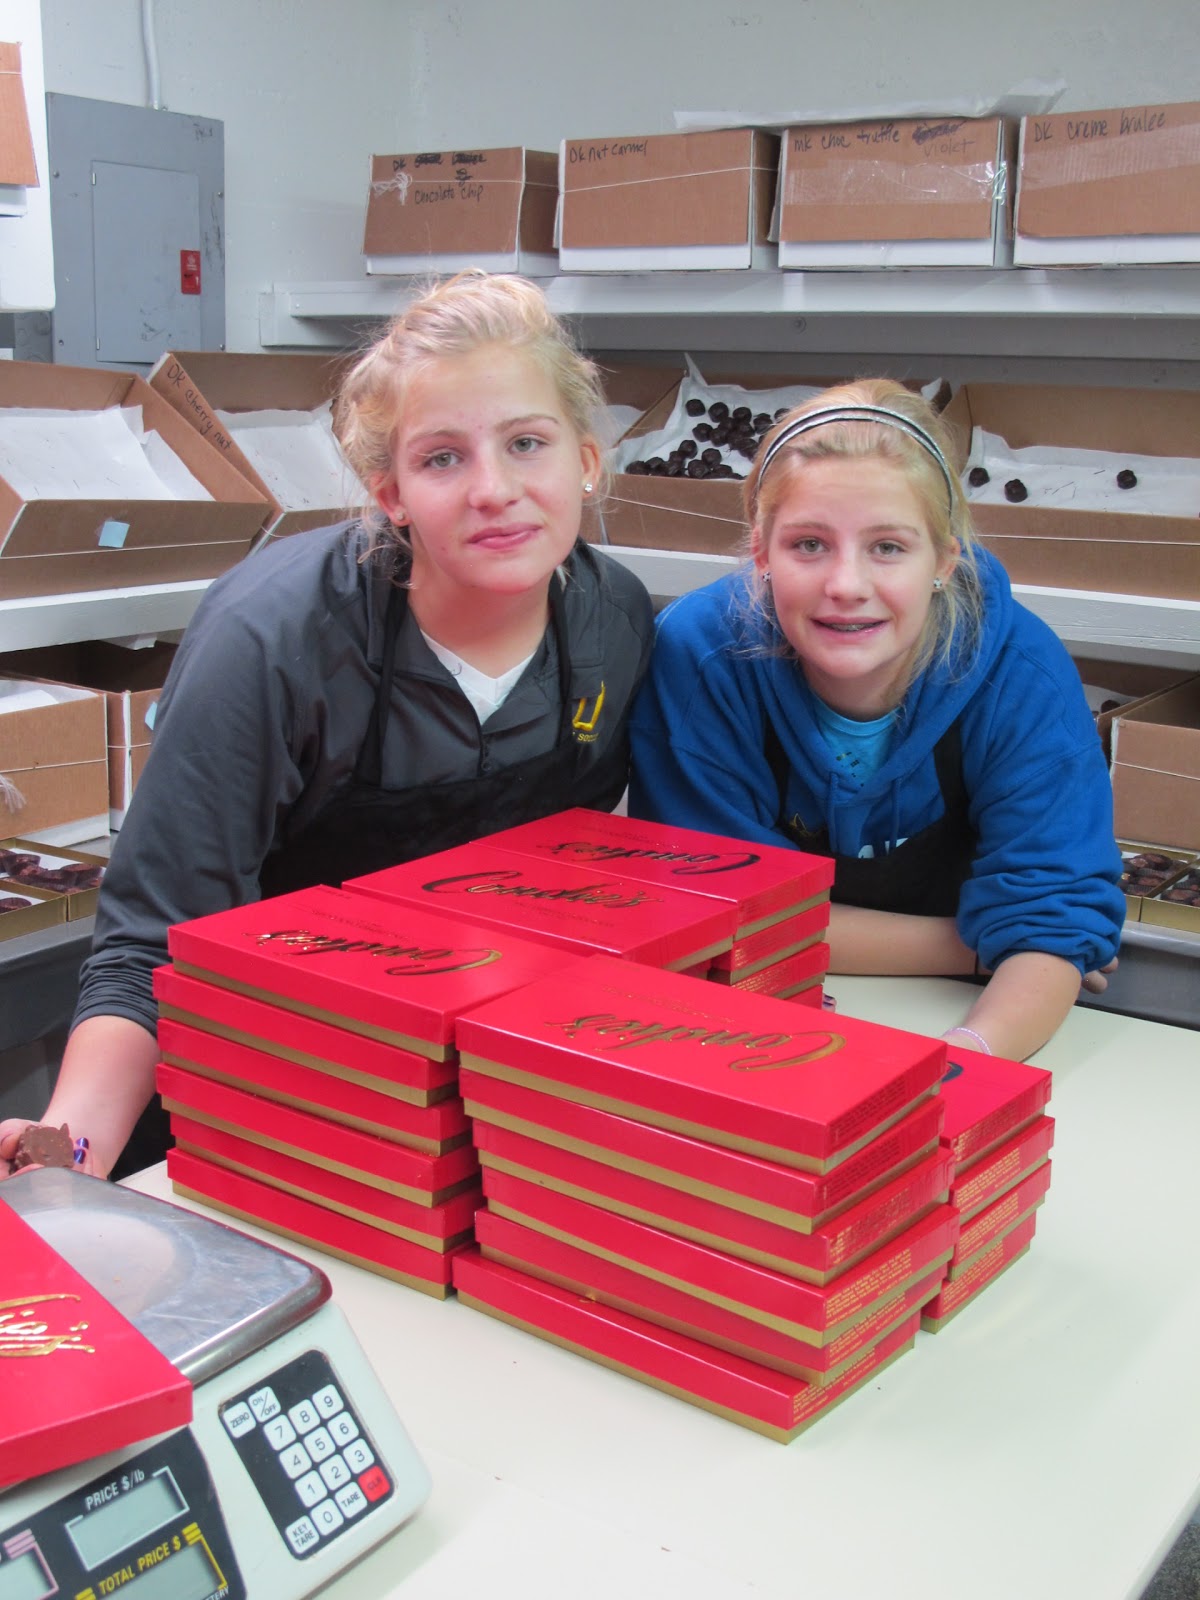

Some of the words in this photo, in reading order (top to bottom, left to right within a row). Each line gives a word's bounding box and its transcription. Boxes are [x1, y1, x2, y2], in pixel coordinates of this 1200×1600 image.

[251, 1396, 264, 1407] ON
[323, 1394, 335, 1408] 9
[263, 1402, 278, 1418] OFF
[299, 1409, 311, 1424] 8
[229, 1411, 251, 1430] ZERO
[274, 1424, 285, 1440] 7
[338, 1421, 350, 1436] 6
[314, 1437, 327, 1452] 5
[292, 1453, 302, 1468] 4
[354, 1449, 366, 1464] 3
[331, 1465, 343, 1480] 2
[85, 1481, 120, 1512] PRICE
[306, 1482, 317, 1497] 1
[340, 1490, 362, 1509] TARE
[291, 1522, 310, 1539] KEY
[294, 1530, 316, 1548] TARE
[98, 1564, 136, 1597] TOTAL
[137, 1542, 171, 1573] PRICE
[172, 1534, 182, 1552] $
